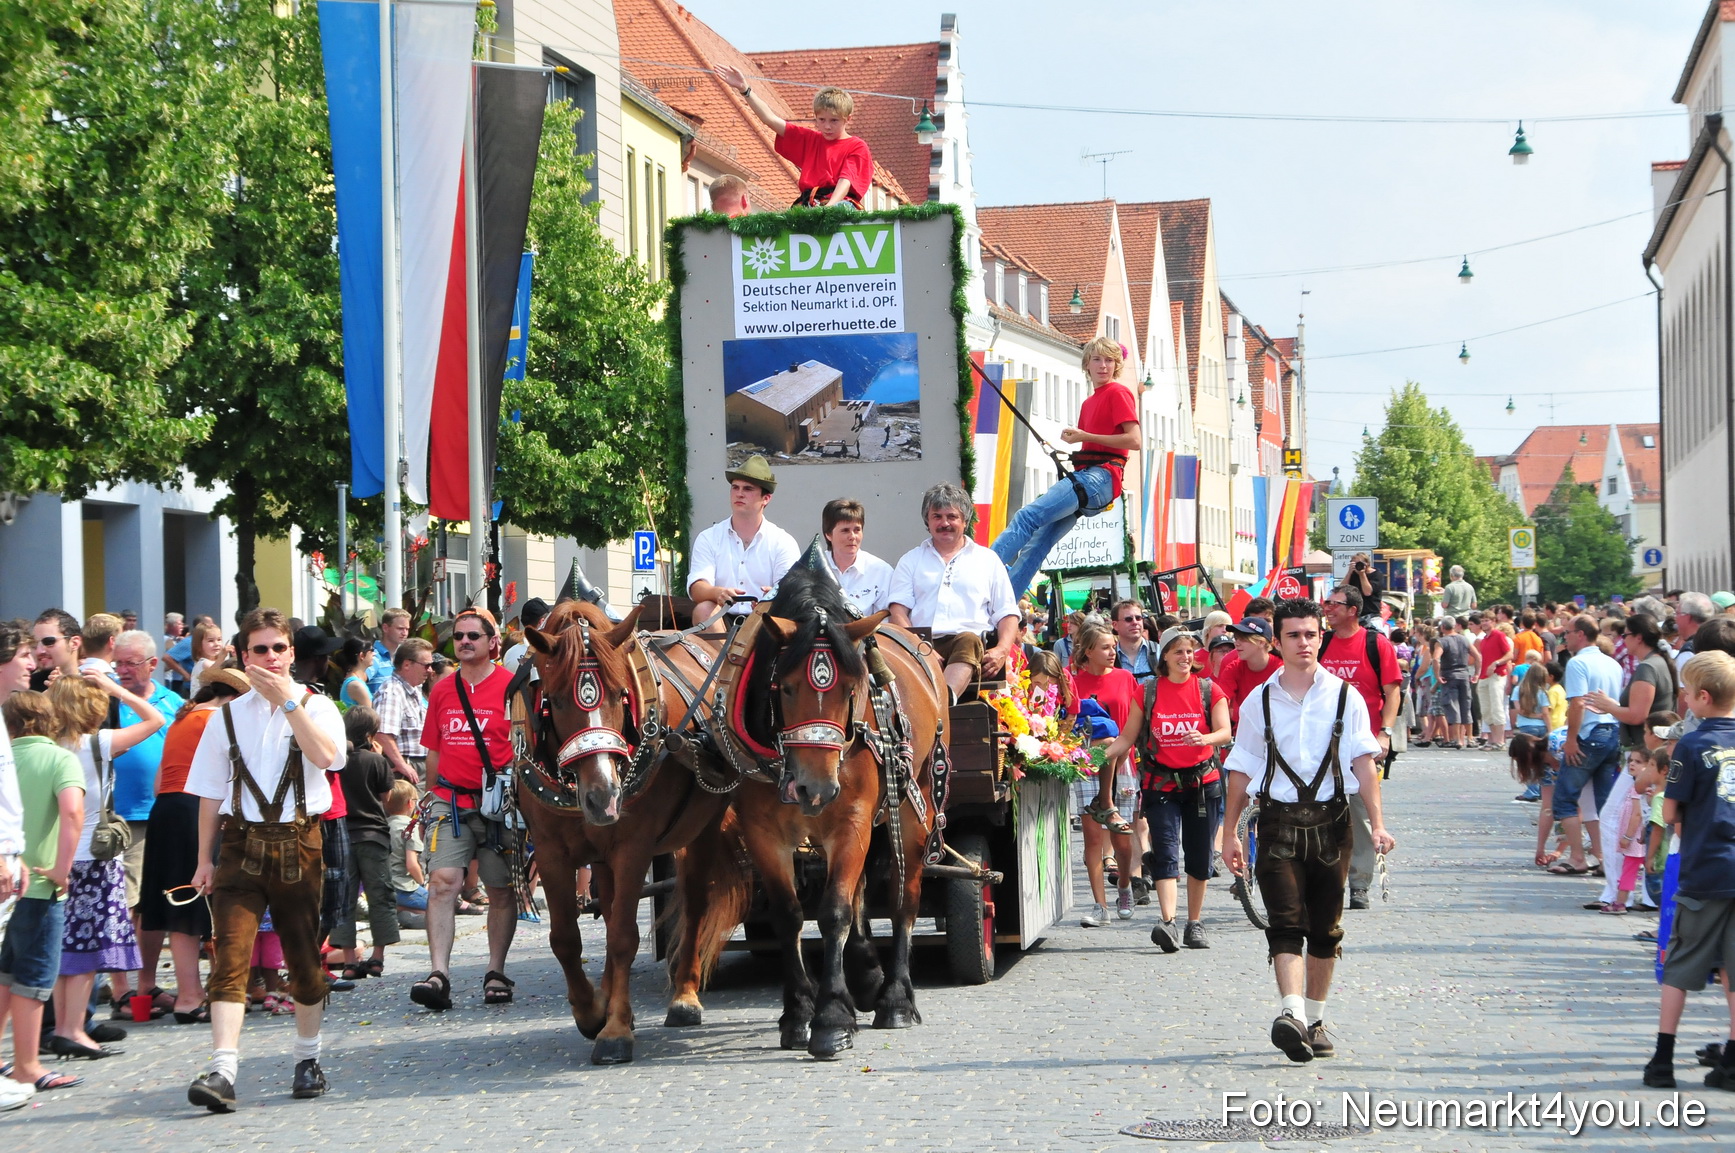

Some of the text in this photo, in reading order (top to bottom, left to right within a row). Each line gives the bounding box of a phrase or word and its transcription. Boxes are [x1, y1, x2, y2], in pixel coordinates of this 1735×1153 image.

[789, 230, 889, 272] DAV
[742, 279, 897, 297] Deutscher Alpenverein
[743, 296, 897, 313] Sektion Neumarkt i.d. OPf.
[744, 317, 897, 335] www.olpererhuette.de
[1072, 518, 1119, 531] stlicher
[1056, 536, 1107, 552] fadfinder
[1340, 534, 1365, 543] ZONE
[639, 536, 651, 565] P
[1046, 548, 1112, 567] Woffenbach
[1280, 586, 1298, 596] FCN
[1161, 721, 1199, 736] DAV
